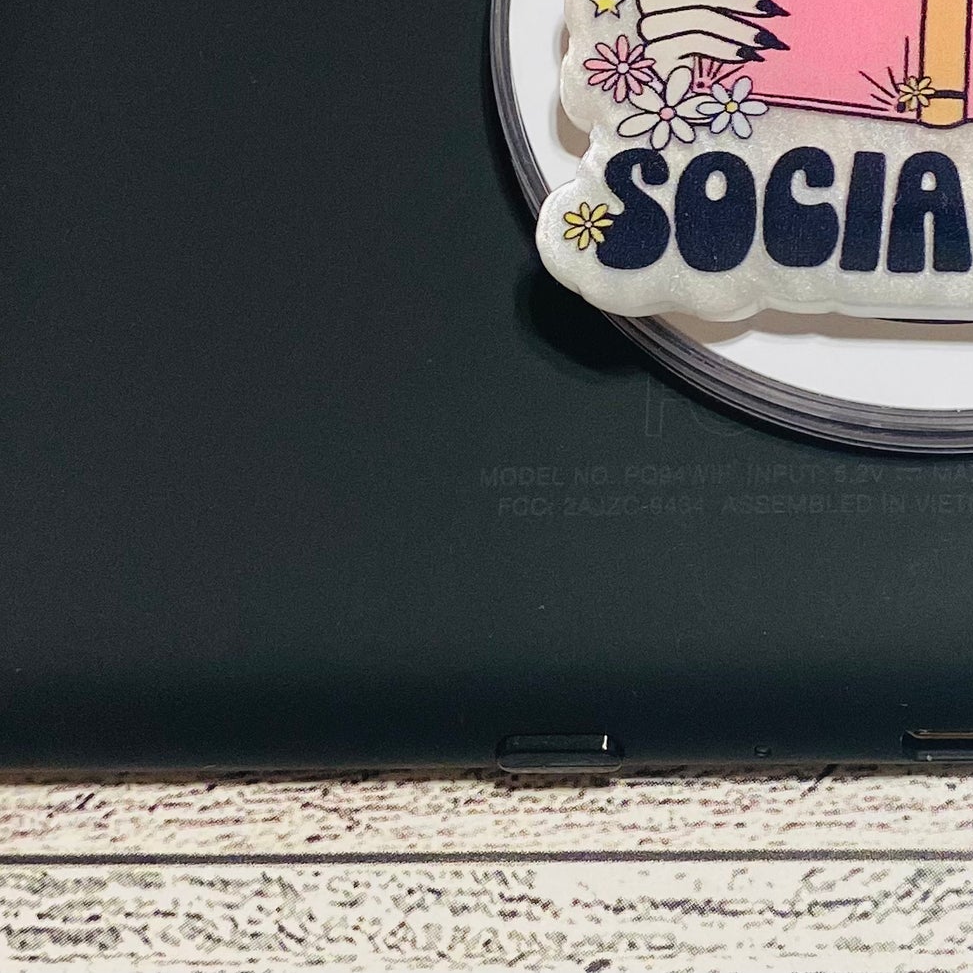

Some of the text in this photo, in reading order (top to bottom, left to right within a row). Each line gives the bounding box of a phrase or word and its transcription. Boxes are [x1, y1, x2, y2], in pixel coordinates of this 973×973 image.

[480, 466, 564, 486] MODEL
[721, 494, 872, 514] ASSEMBLED
[882, 492, 905, 514] IN
